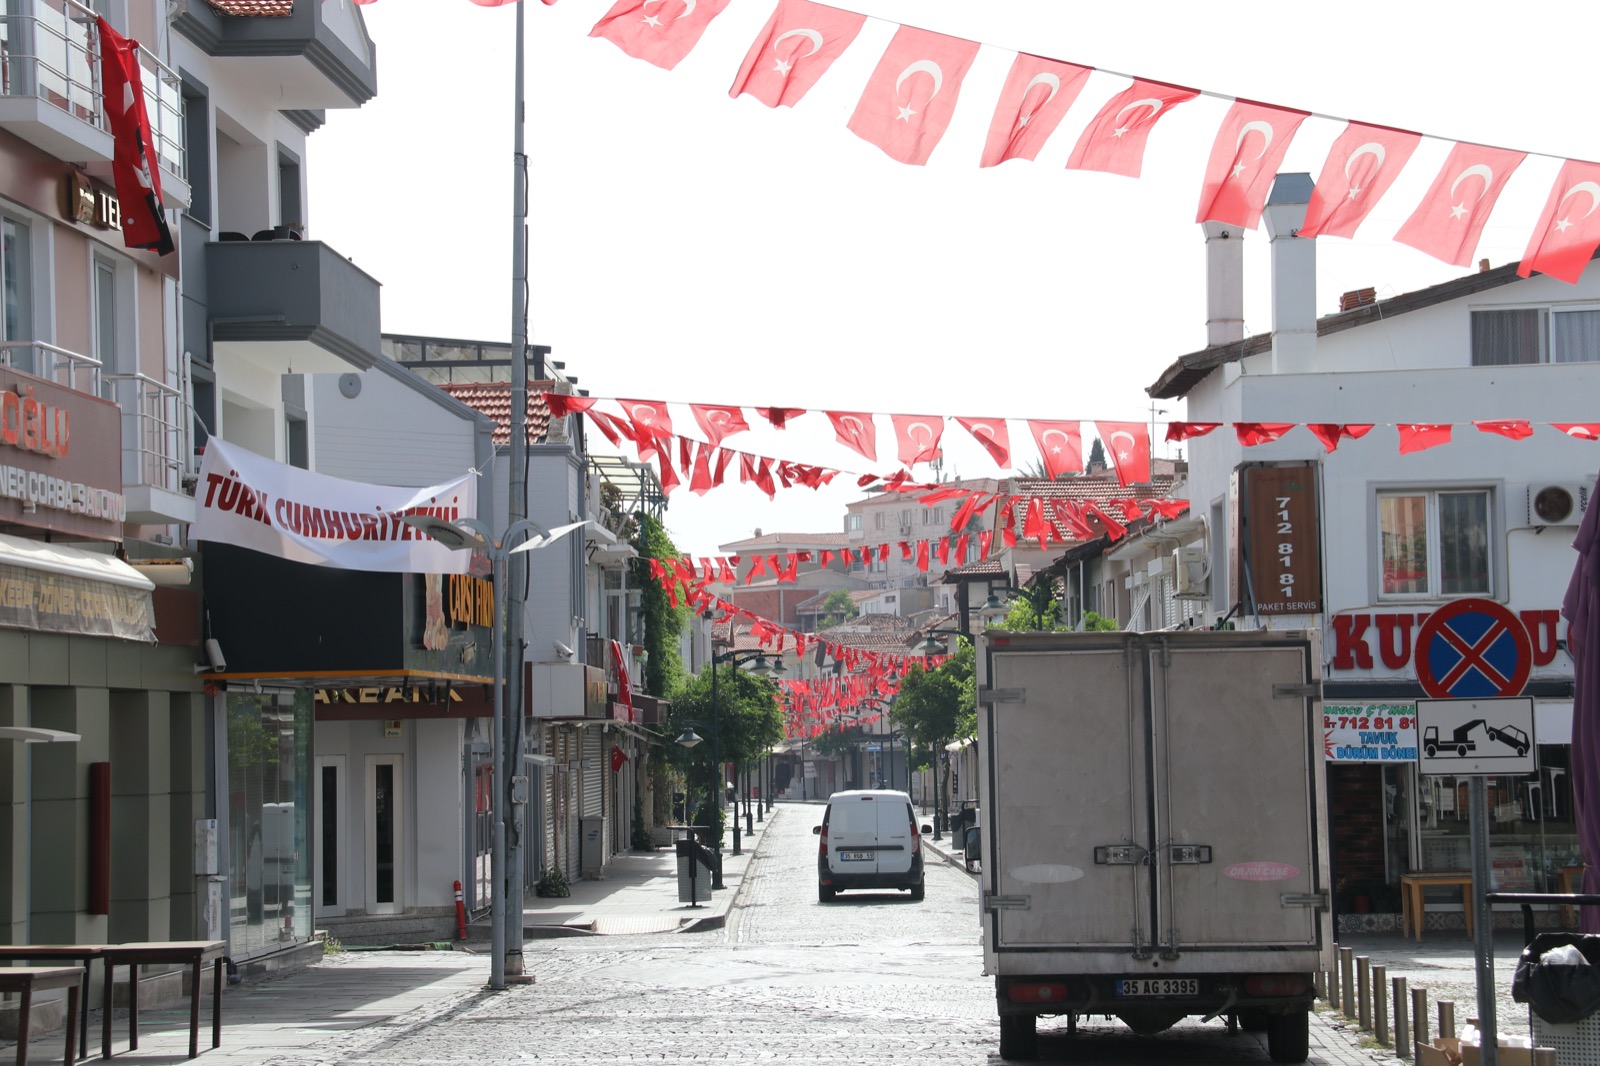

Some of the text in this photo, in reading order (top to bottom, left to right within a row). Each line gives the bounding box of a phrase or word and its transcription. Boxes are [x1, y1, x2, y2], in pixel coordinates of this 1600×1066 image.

[28, 471, 75, 514] ÇORBA
[76, 483, 126, 522] SALONU
[204, 469, 271, 526] TÜRK
[1257, 600, 1317, 611] PAKET SERVİS
[1338, 716, 1370, 730] 712
[1373, 716, 1393, 730] 81
[1358, 731, 1399, 745] TAVUK
[1336, 744, 1417, 760] DÜRÜM DÖNE
[1123, 981, 1139, 994] 35
[1143, 981, 1160, 994] AG
[1163, 980, 1197, 994] 3395
